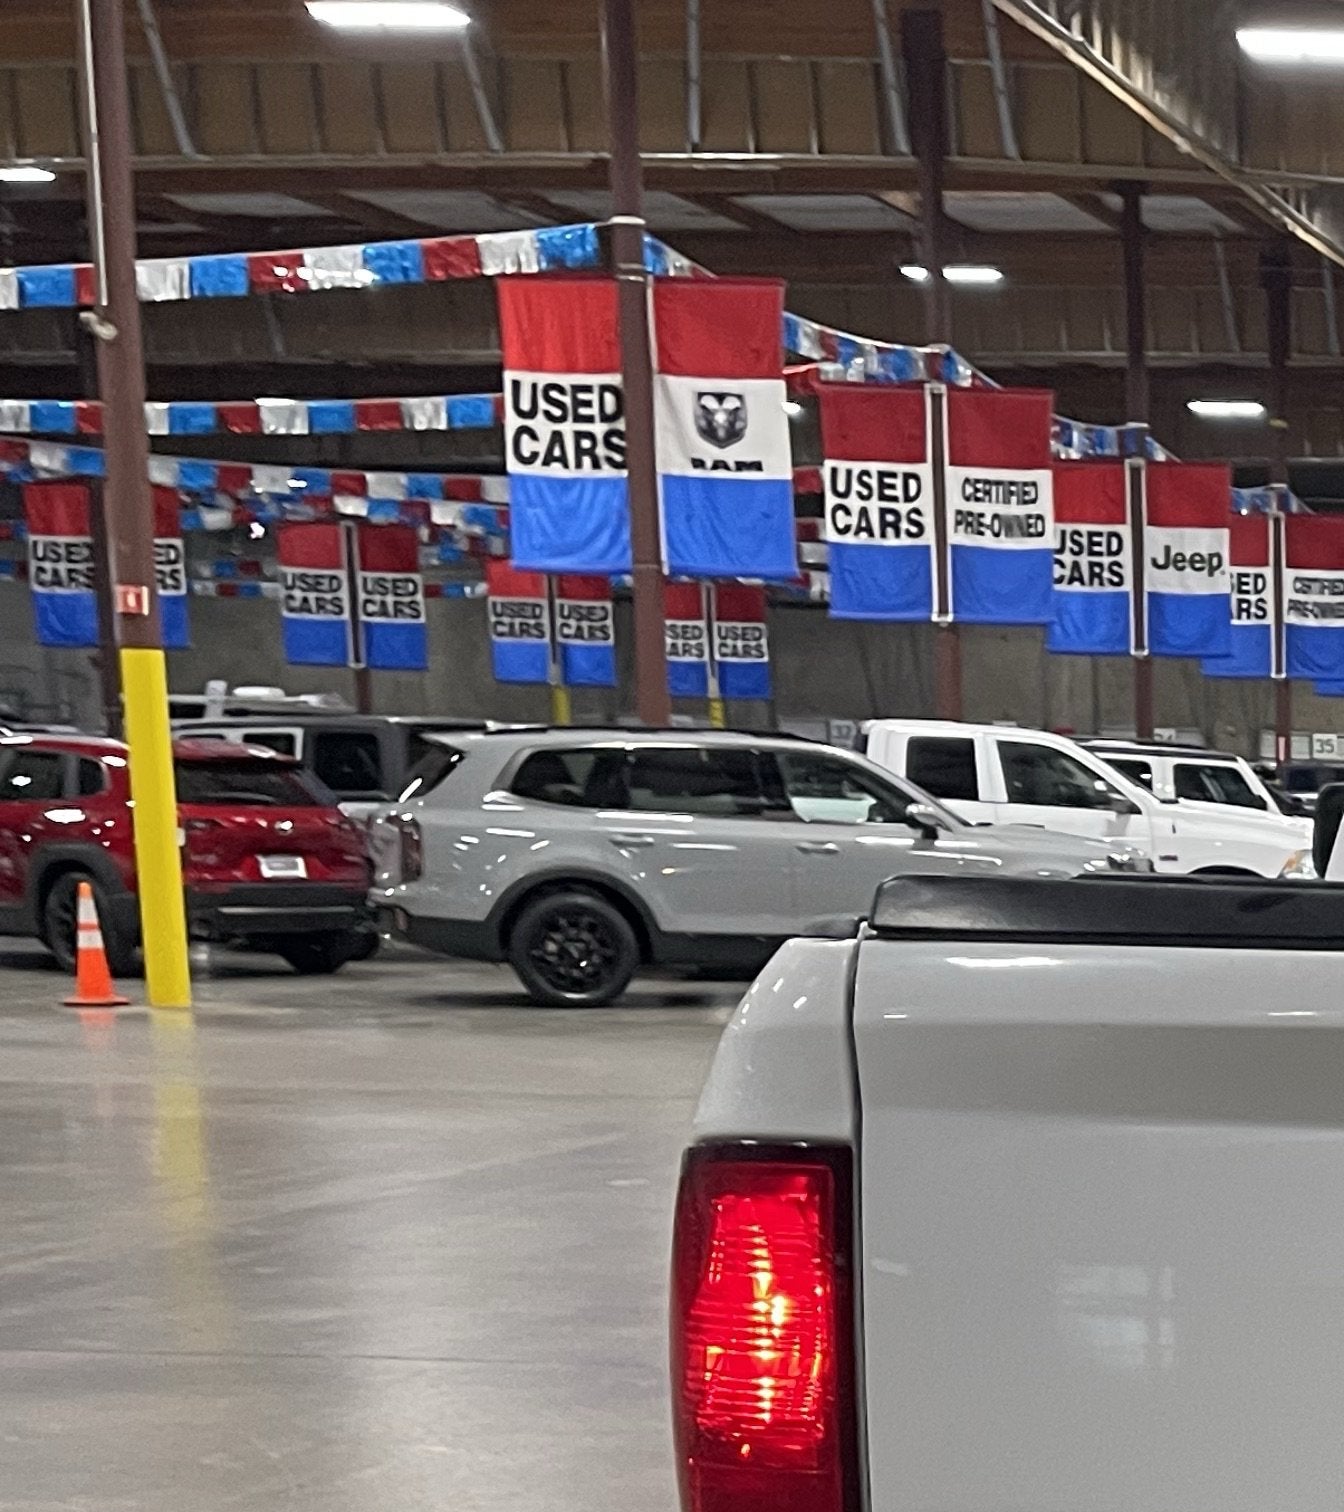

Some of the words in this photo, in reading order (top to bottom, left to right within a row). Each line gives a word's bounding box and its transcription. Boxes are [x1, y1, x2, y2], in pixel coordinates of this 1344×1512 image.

[511, 379, 624, 424] USED
[512, 425, 627, 470] CARS
[830, 467, 922, 504] USED
[962, 477, 1038, 505] CERTIFIED
[831, 504, 925, 539] CARS
[1151, 545, 1223, 577] Jeep
[285, 574, 342, 594] USED
[362, 577, 418, 598] USED
[285, 596, 345, 616] CARS
[362, 599, 422, 619] CARS
[492, 601, 543, 619] USED
[559, 604, 609, 621] USED
[559, 623, 611, 641] CARS
[666, 624, 703, 641] SED
[717, 625, 763, 642] USED
[666, 642, 705, 658] ARS
[717, 642, 764, 659] CARS
[1315, 739, 1335, 753] 35
